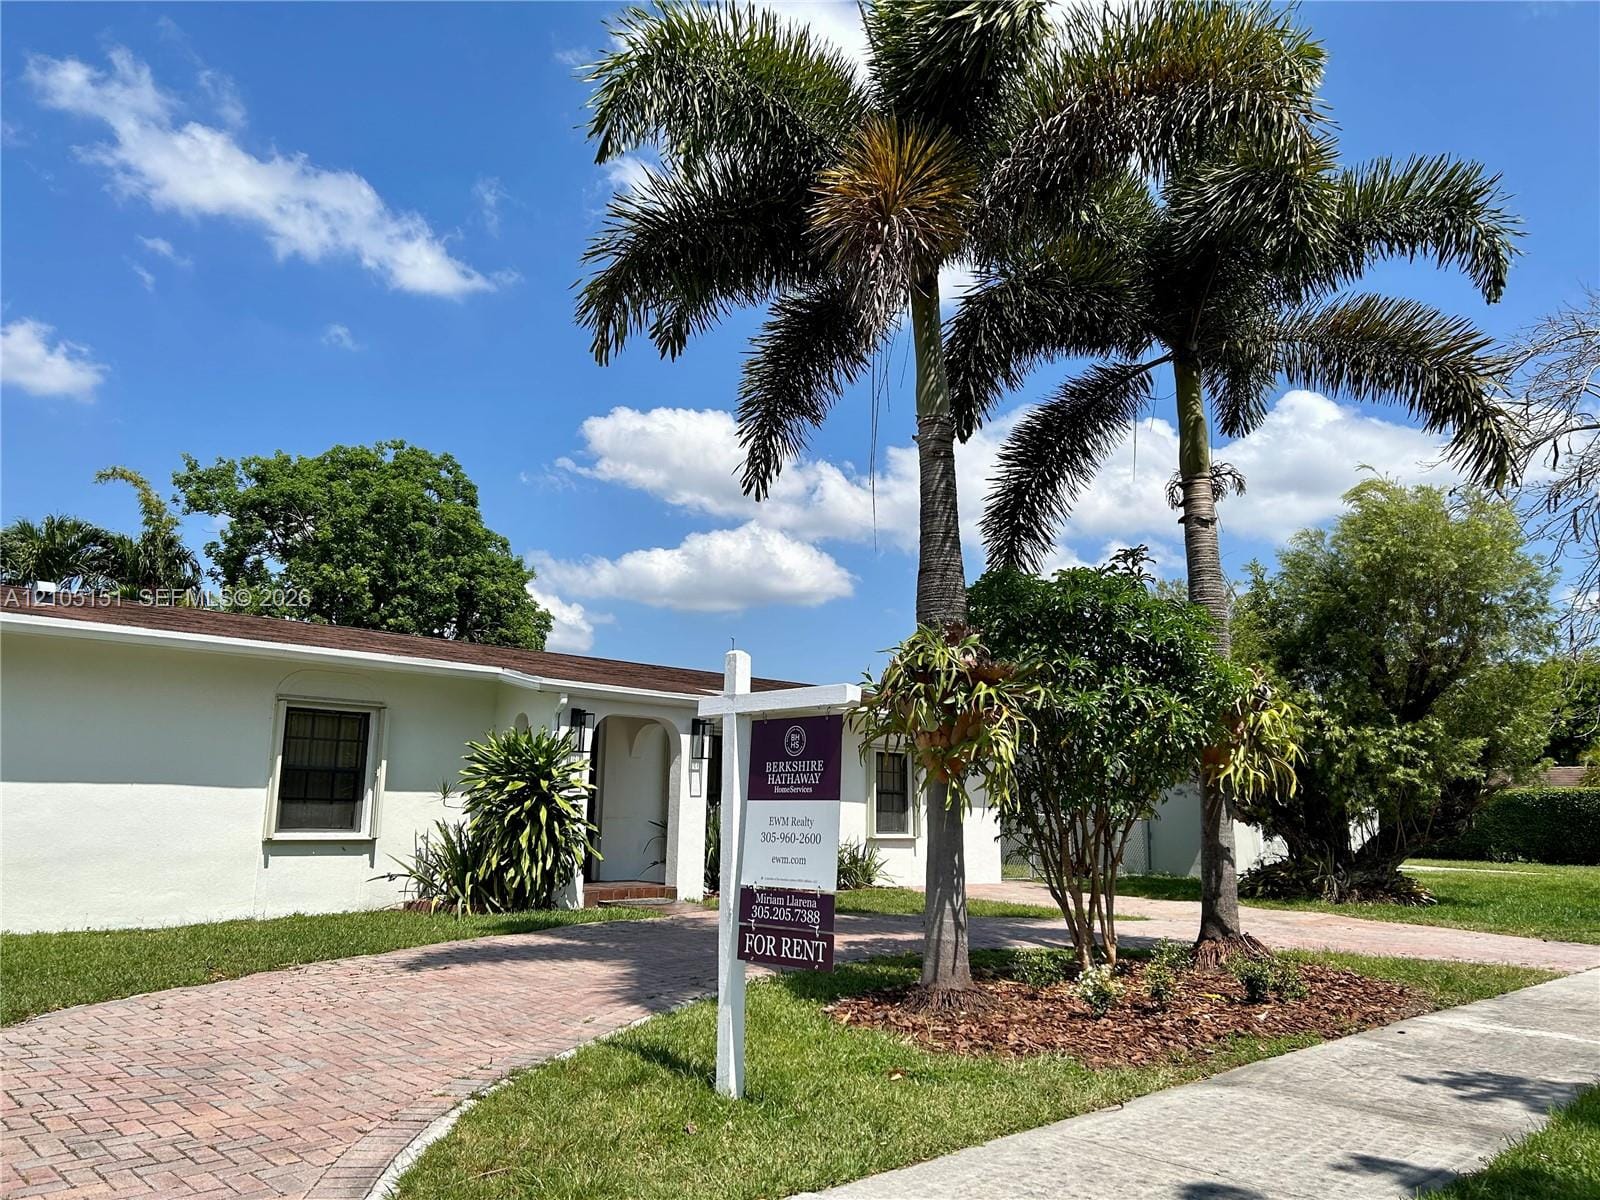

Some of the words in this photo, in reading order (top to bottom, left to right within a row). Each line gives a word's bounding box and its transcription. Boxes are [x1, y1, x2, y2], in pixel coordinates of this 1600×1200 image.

[766, 760, 824, 773] BERKSHIRE
[767, 773, 821, 785] HATHAWAY
[774, 785, 813, 794] HomeServices
[769, 816, 789, 826] EWM
[791, 816, 815, 829] Realty
[760, 832, 822, 845] 305-960-2600
[771, 855, 807, 865] ewm.com
[755, 892, 785, 906] Miriam
[786, 894, 817, 909] Llarena
[751, 904, 821, 925] 305.205.7388
[744, 933, 777, 957] FOR
[780, 937, 827, 963] RENT
